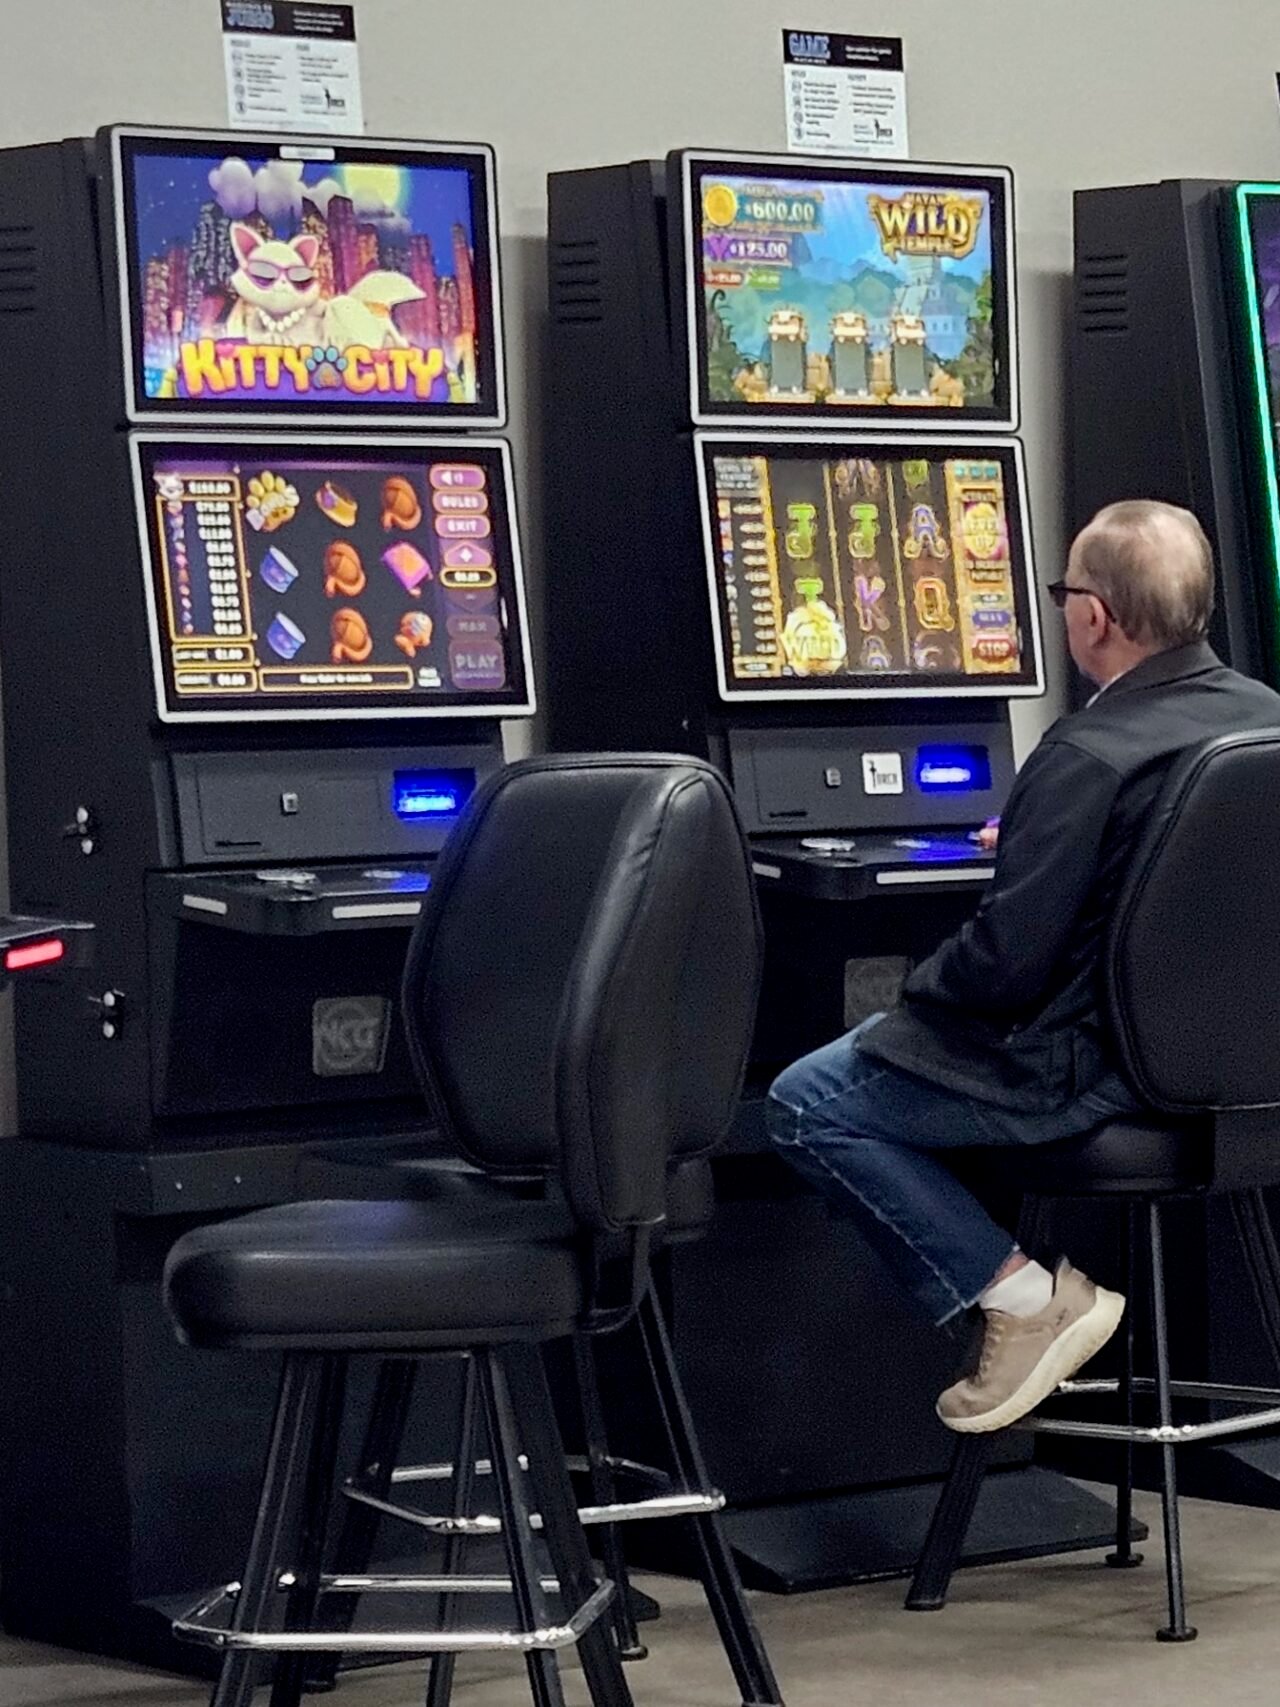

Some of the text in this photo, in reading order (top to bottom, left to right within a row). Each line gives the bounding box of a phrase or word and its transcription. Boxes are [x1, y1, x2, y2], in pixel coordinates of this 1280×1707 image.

[789, 32, 830, 58] GAME
[880, 201, 970, 242] WILD
[441, 495, 480, 509] RULES
[447, 519, 477, 533] EXIT
[978, 640, 1010, 657] STOP
[455, 653, 498, 669] PLAY
